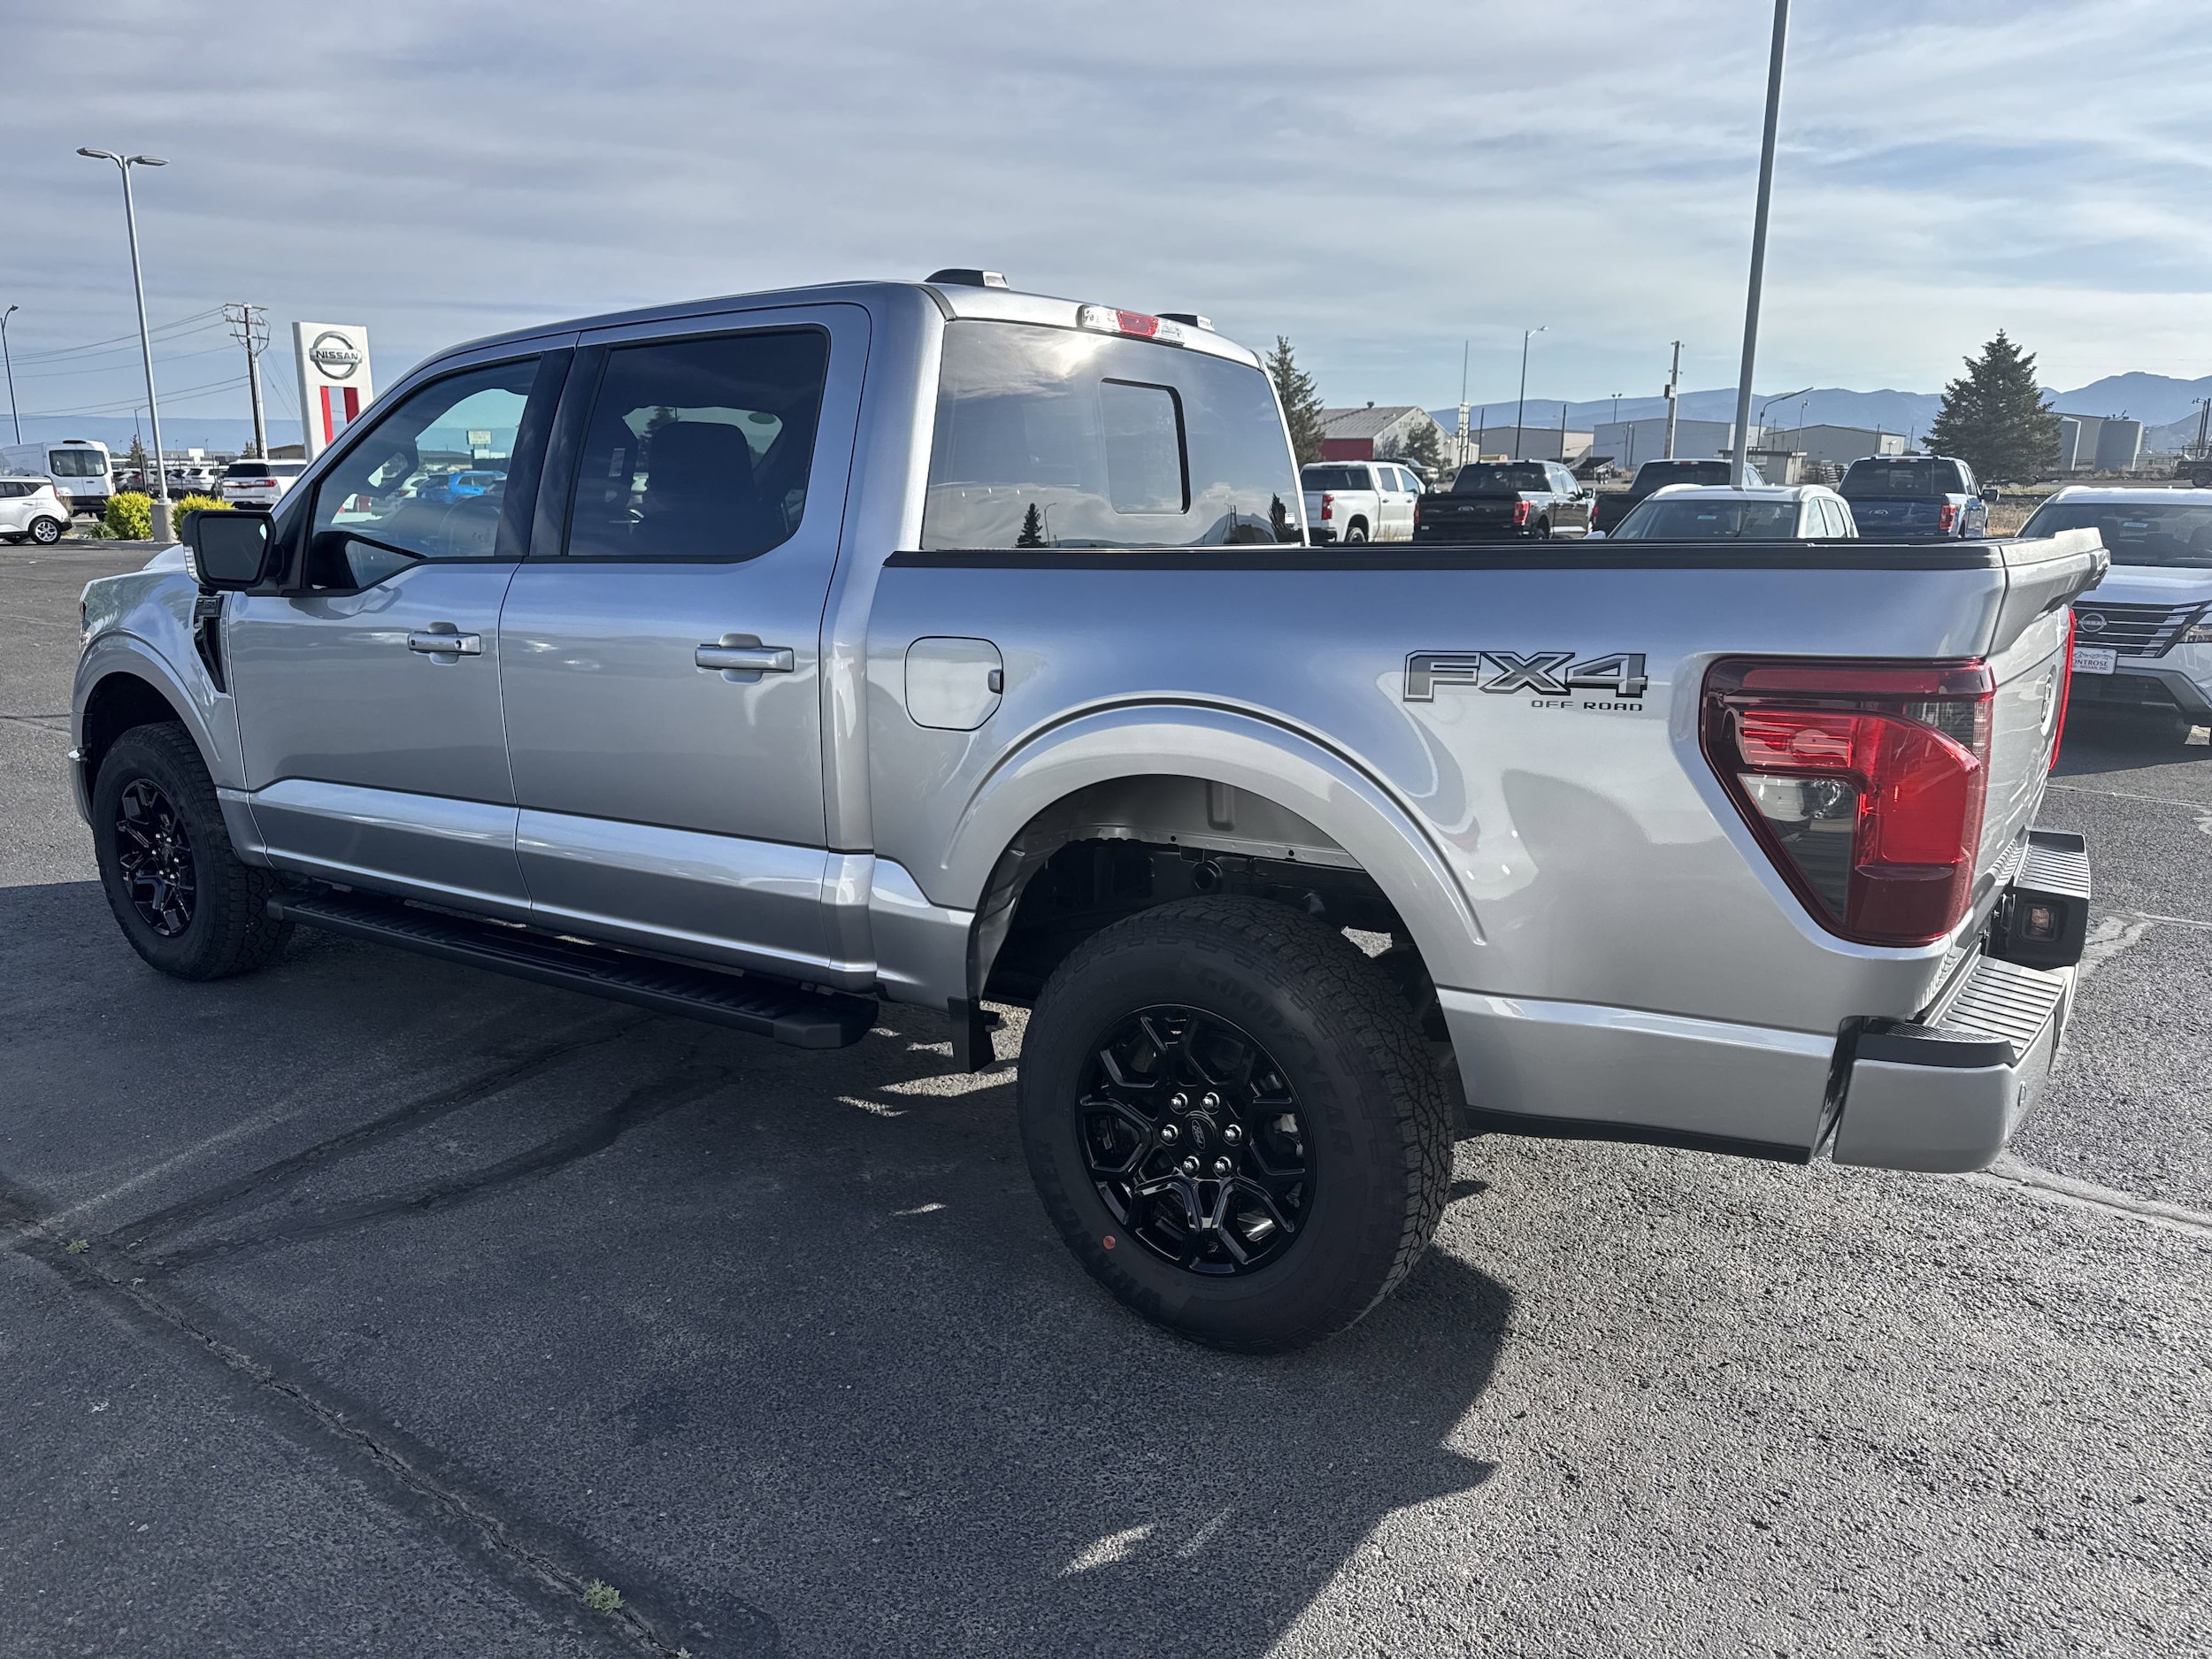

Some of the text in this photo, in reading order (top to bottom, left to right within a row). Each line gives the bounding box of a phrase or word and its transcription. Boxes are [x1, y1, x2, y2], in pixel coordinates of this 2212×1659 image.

[316, 350, 358, 360] NISSAN
[2072, 658, 2108, 667] ONTROSE
[1402, 649, 1648, 703] FX4
[1531, 700, 1643, 711] OFF ROAD
